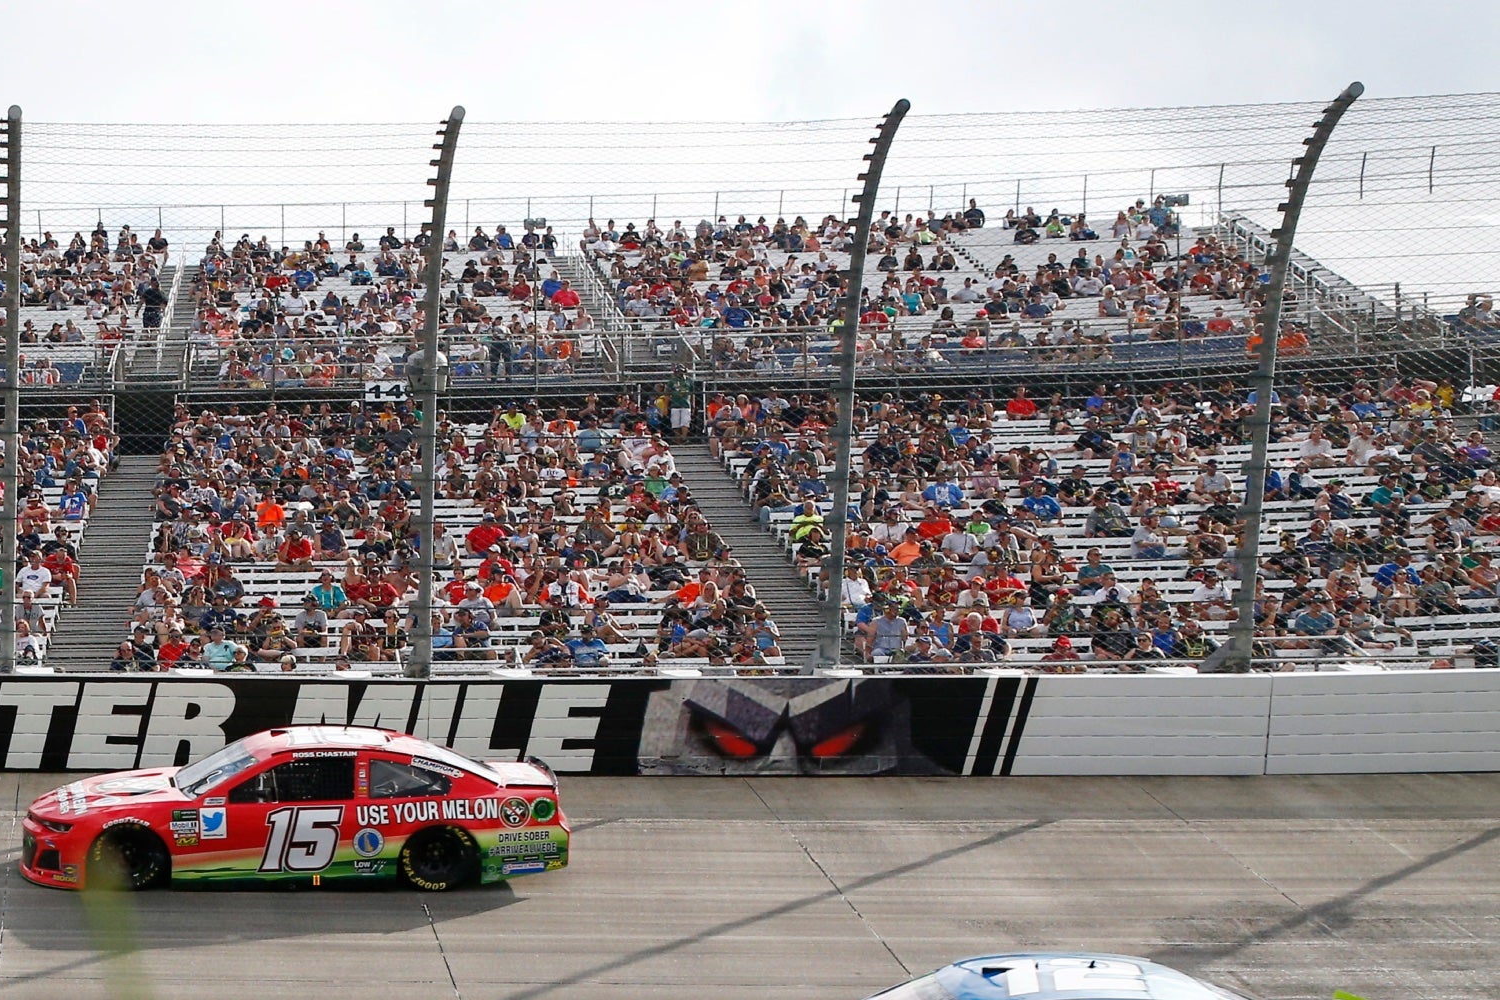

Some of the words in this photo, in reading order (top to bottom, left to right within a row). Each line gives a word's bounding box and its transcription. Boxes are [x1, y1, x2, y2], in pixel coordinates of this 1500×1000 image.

[368, 384, 408, 399] 14
[289, 683, 611, 772] MILE
[292, 751, 315, 759] ROSS
[412, 758, 455, 773] CHAMPION
[356, 805, 390, 826] USE
[392, 801, 440, 823] YOUR
[441, 798, 498, 820] MELON
[102, 816, 150, 829] GOODYEAR
[257, 805, 345, 873] 15
[498, 832, 523, 843] DRIVE
[523, 831, 550, 841] SOBER
[989, 957, 1148, 996] 12
